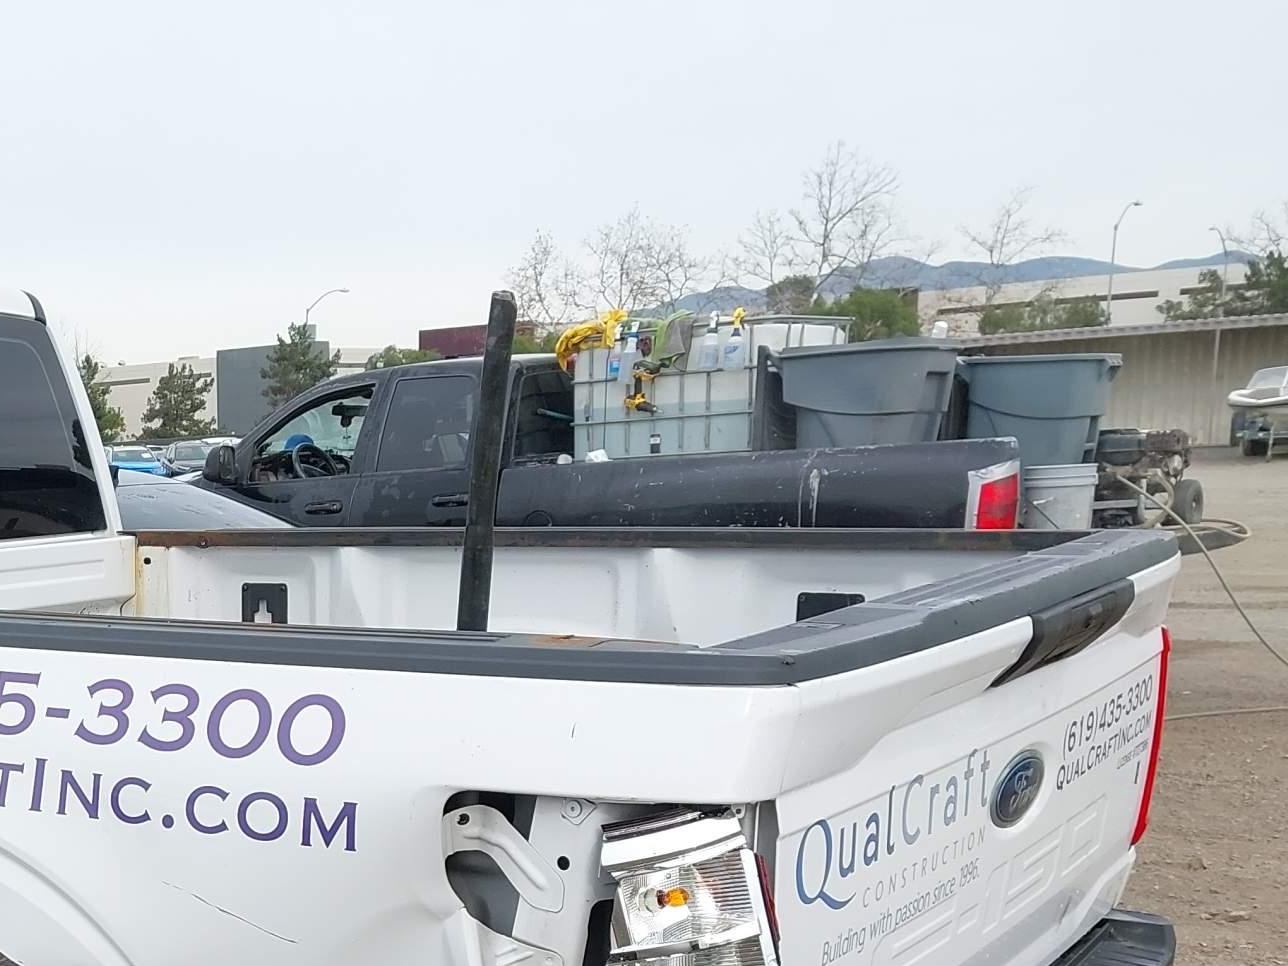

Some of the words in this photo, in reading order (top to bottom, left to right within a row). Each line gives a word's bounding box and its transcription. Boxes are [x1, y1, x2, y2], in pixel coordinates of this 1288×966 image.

[1063, 674, 1152, 761] (619)435-3300
[796, 748, 991, 910] QualCraft
[862, 825, 986, 909] CONSTRUCTION
[821, 927, 867, 966] Building
[869, 909, 894, 941] with
[894, 888, 931, 931] passion
[932, 876, 957, 915] since
[959, 857, 981, 890] 1996.
